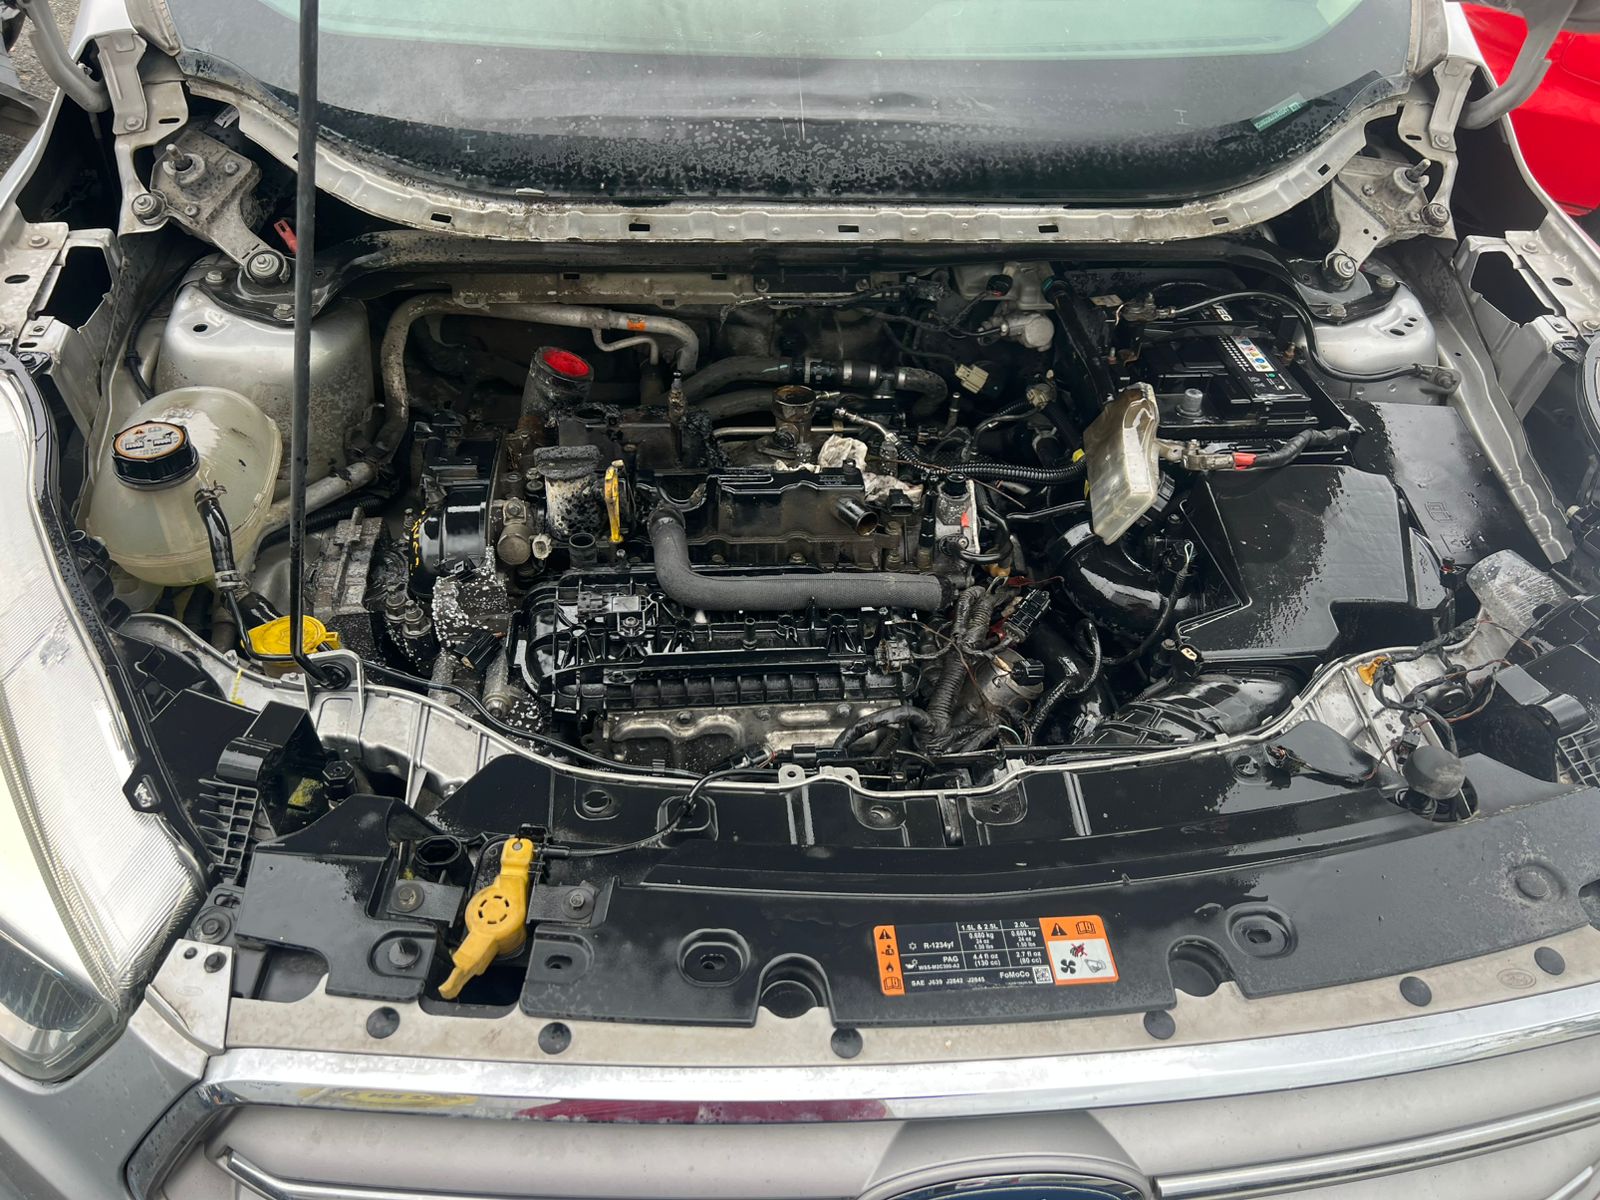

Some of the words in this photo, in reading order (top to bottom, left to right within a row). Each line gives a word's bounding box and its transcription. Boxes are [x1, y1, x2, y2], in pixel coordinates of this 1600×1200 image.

[923, 941, 954, 950] R-1234yf
[942, 955, 959, 963] PAG
[999, 970, 1030, 978] FoMoCo
[911, 979, 925, 987] SAE
